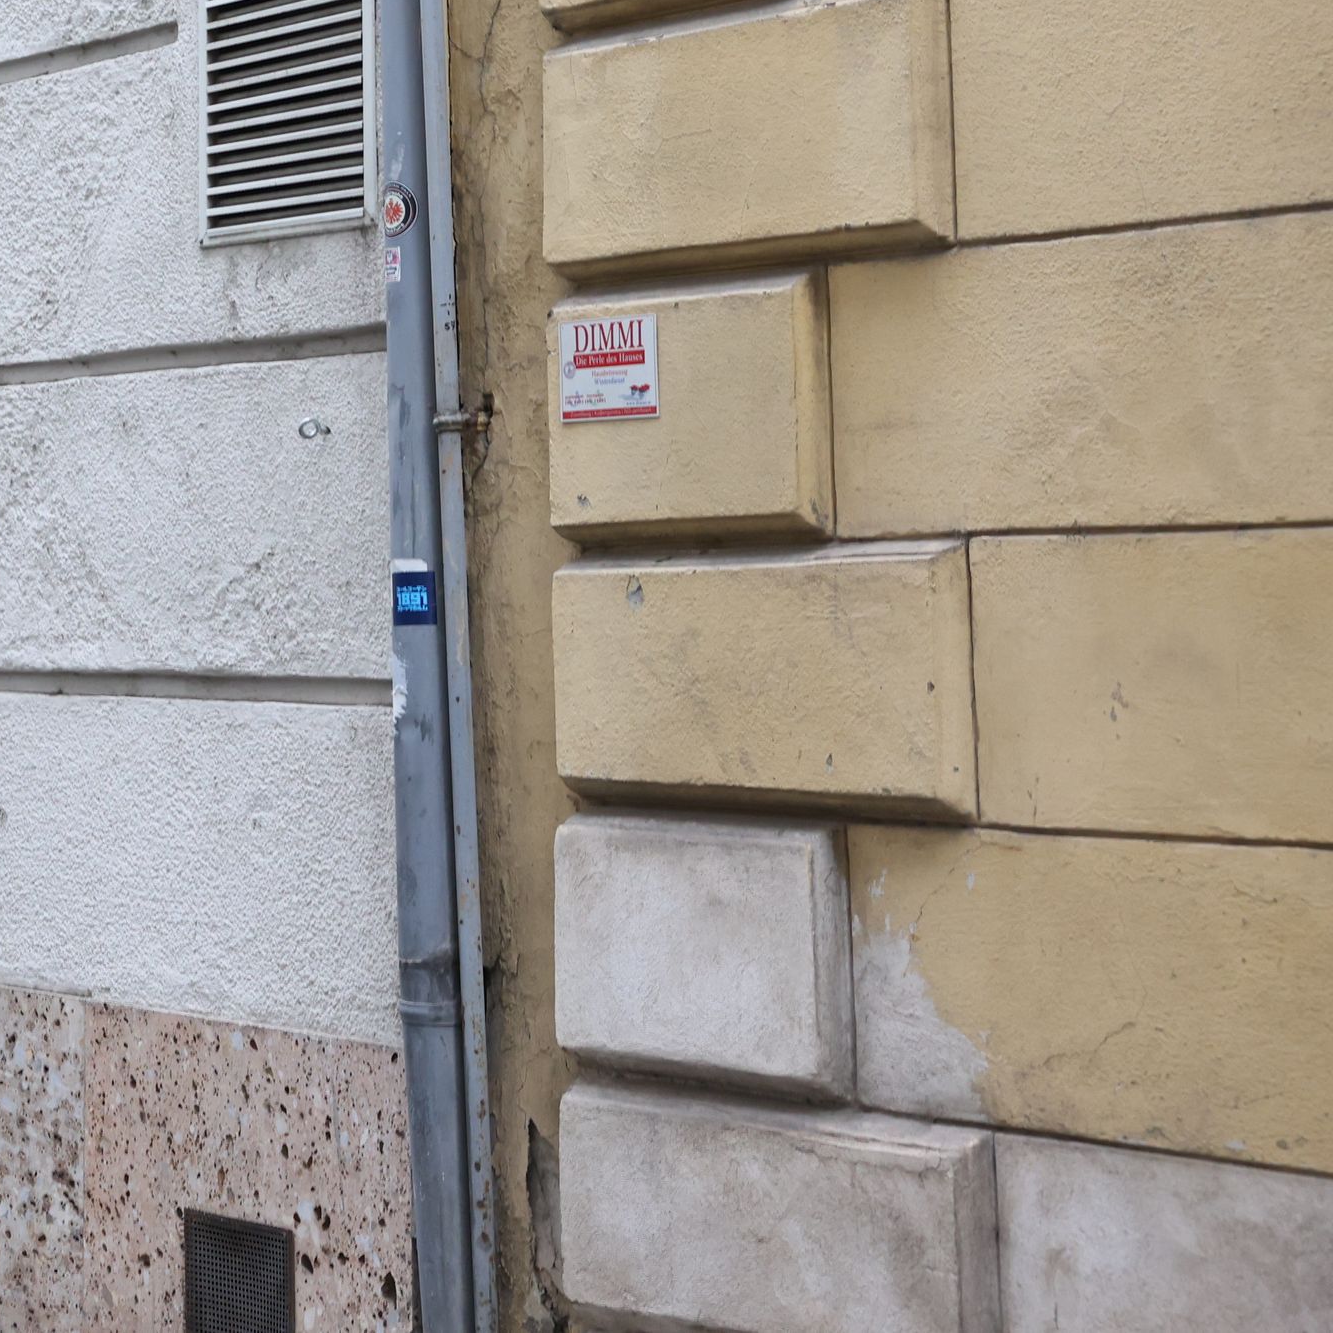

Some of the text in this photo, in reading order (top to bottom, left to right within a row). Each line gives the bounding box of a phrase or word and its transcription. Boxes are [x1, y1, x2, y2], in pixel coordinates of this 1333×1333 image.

[574, 319, 644, 352] DIMMI
[576, 353, 644, 366] Die Perle des Hauses
[396, 592, 428, 607] 1891
